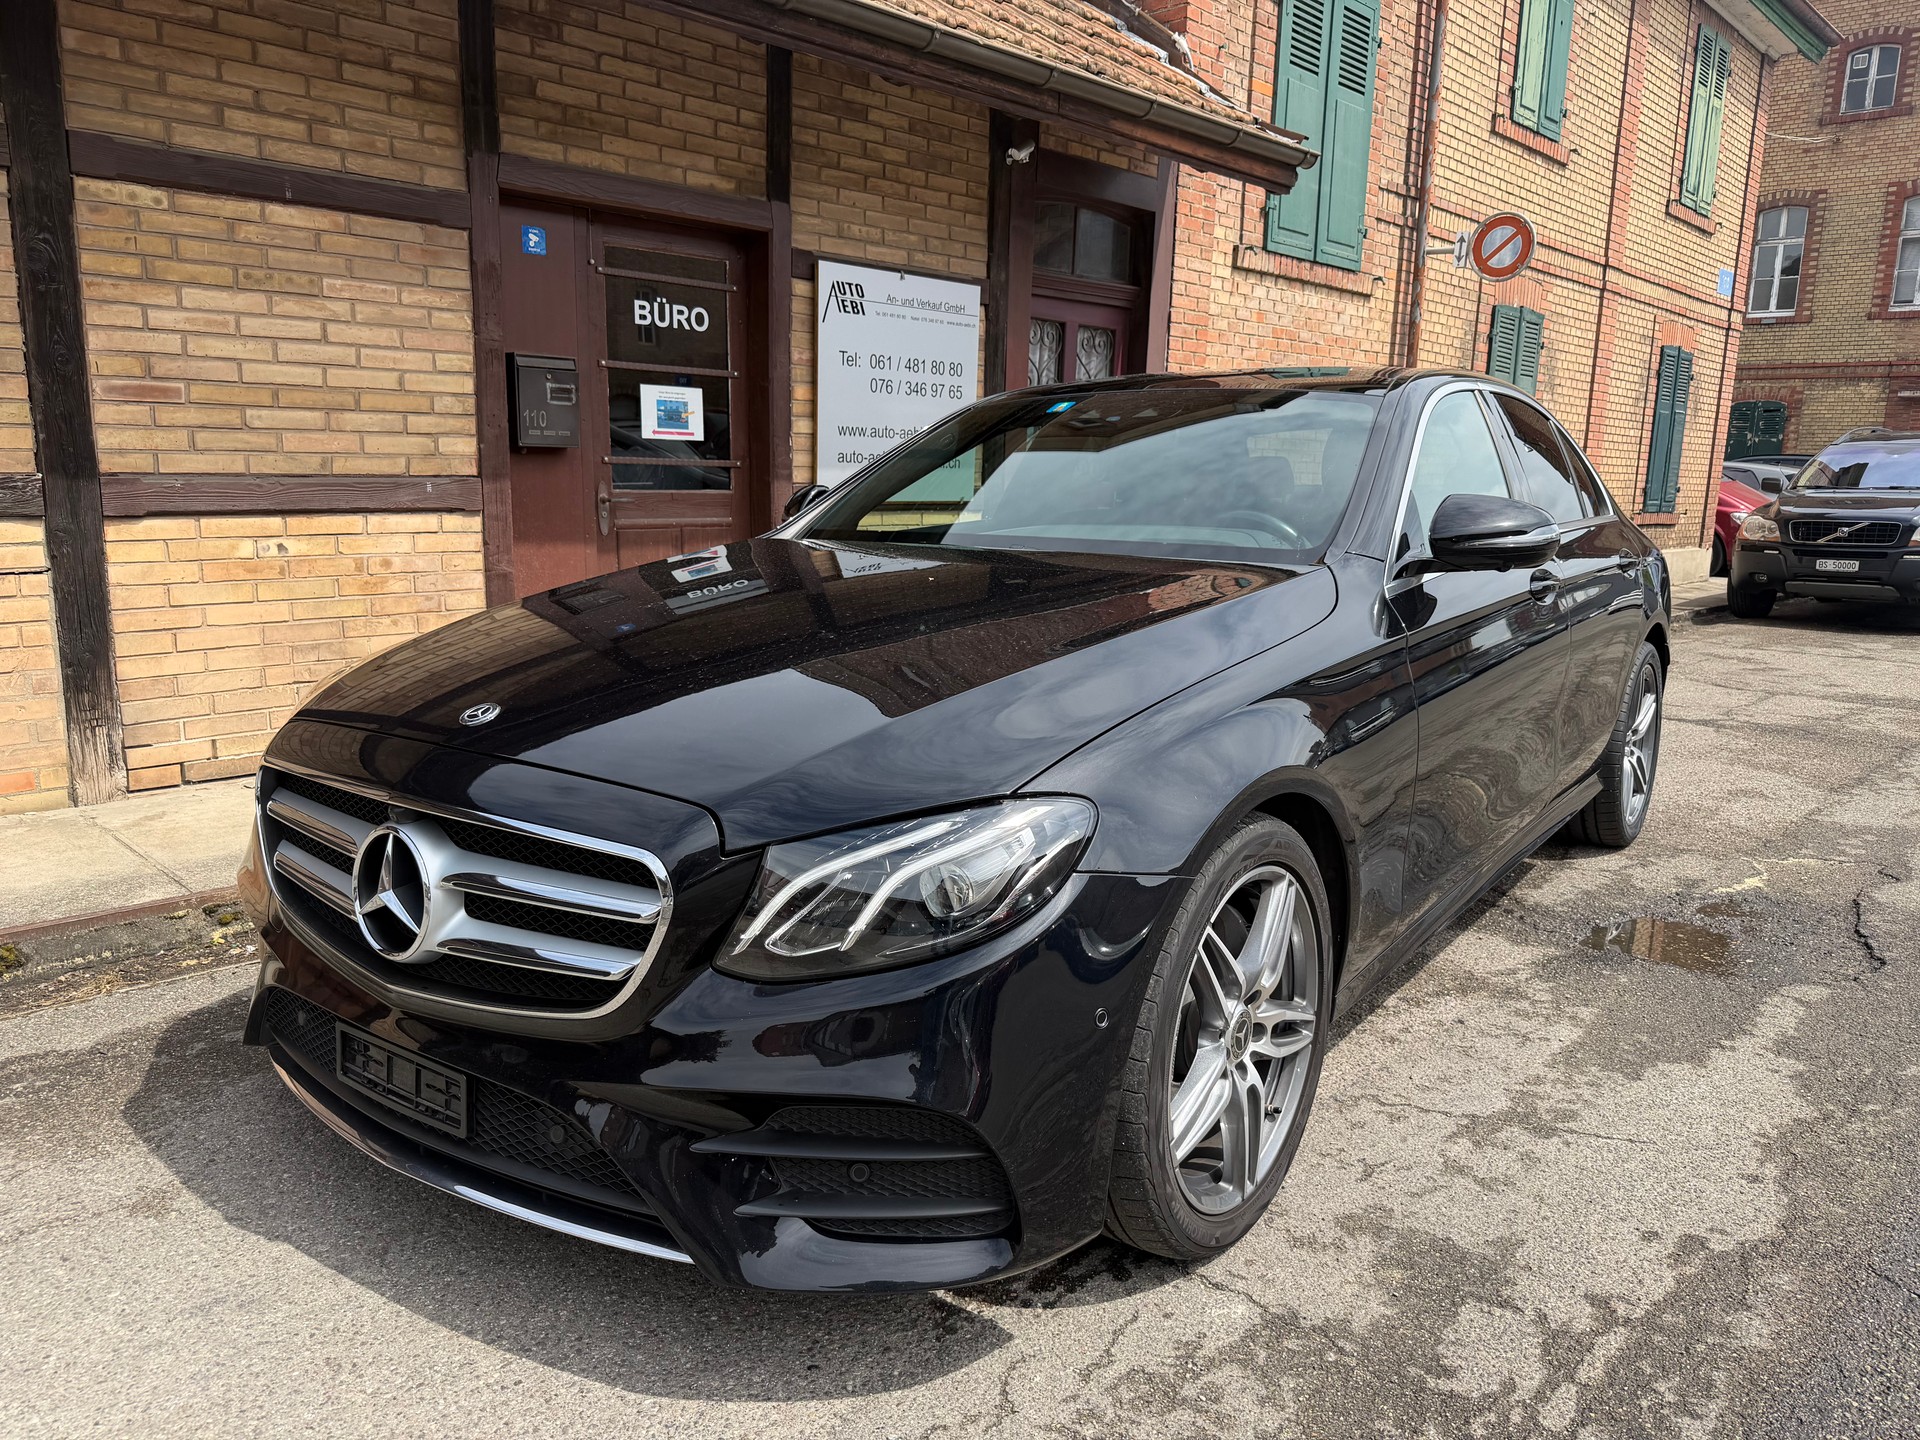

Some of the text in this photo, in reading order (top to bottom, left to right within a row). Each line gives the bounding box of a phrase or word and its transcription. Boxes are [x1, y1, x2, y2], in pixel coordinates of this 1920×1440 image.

[886, 293, 966, 313] An- und Verkauf GmbH
[634, 297, 709, 332] BÜRO
[839, 350, 963, 377] Tel: 061 / 481 80 80
[870, 378, 963, 400] 076 / 346 97 65
[523, 409, 547, 428] 110
[1818, 560, 1857, 570] BS 50000
